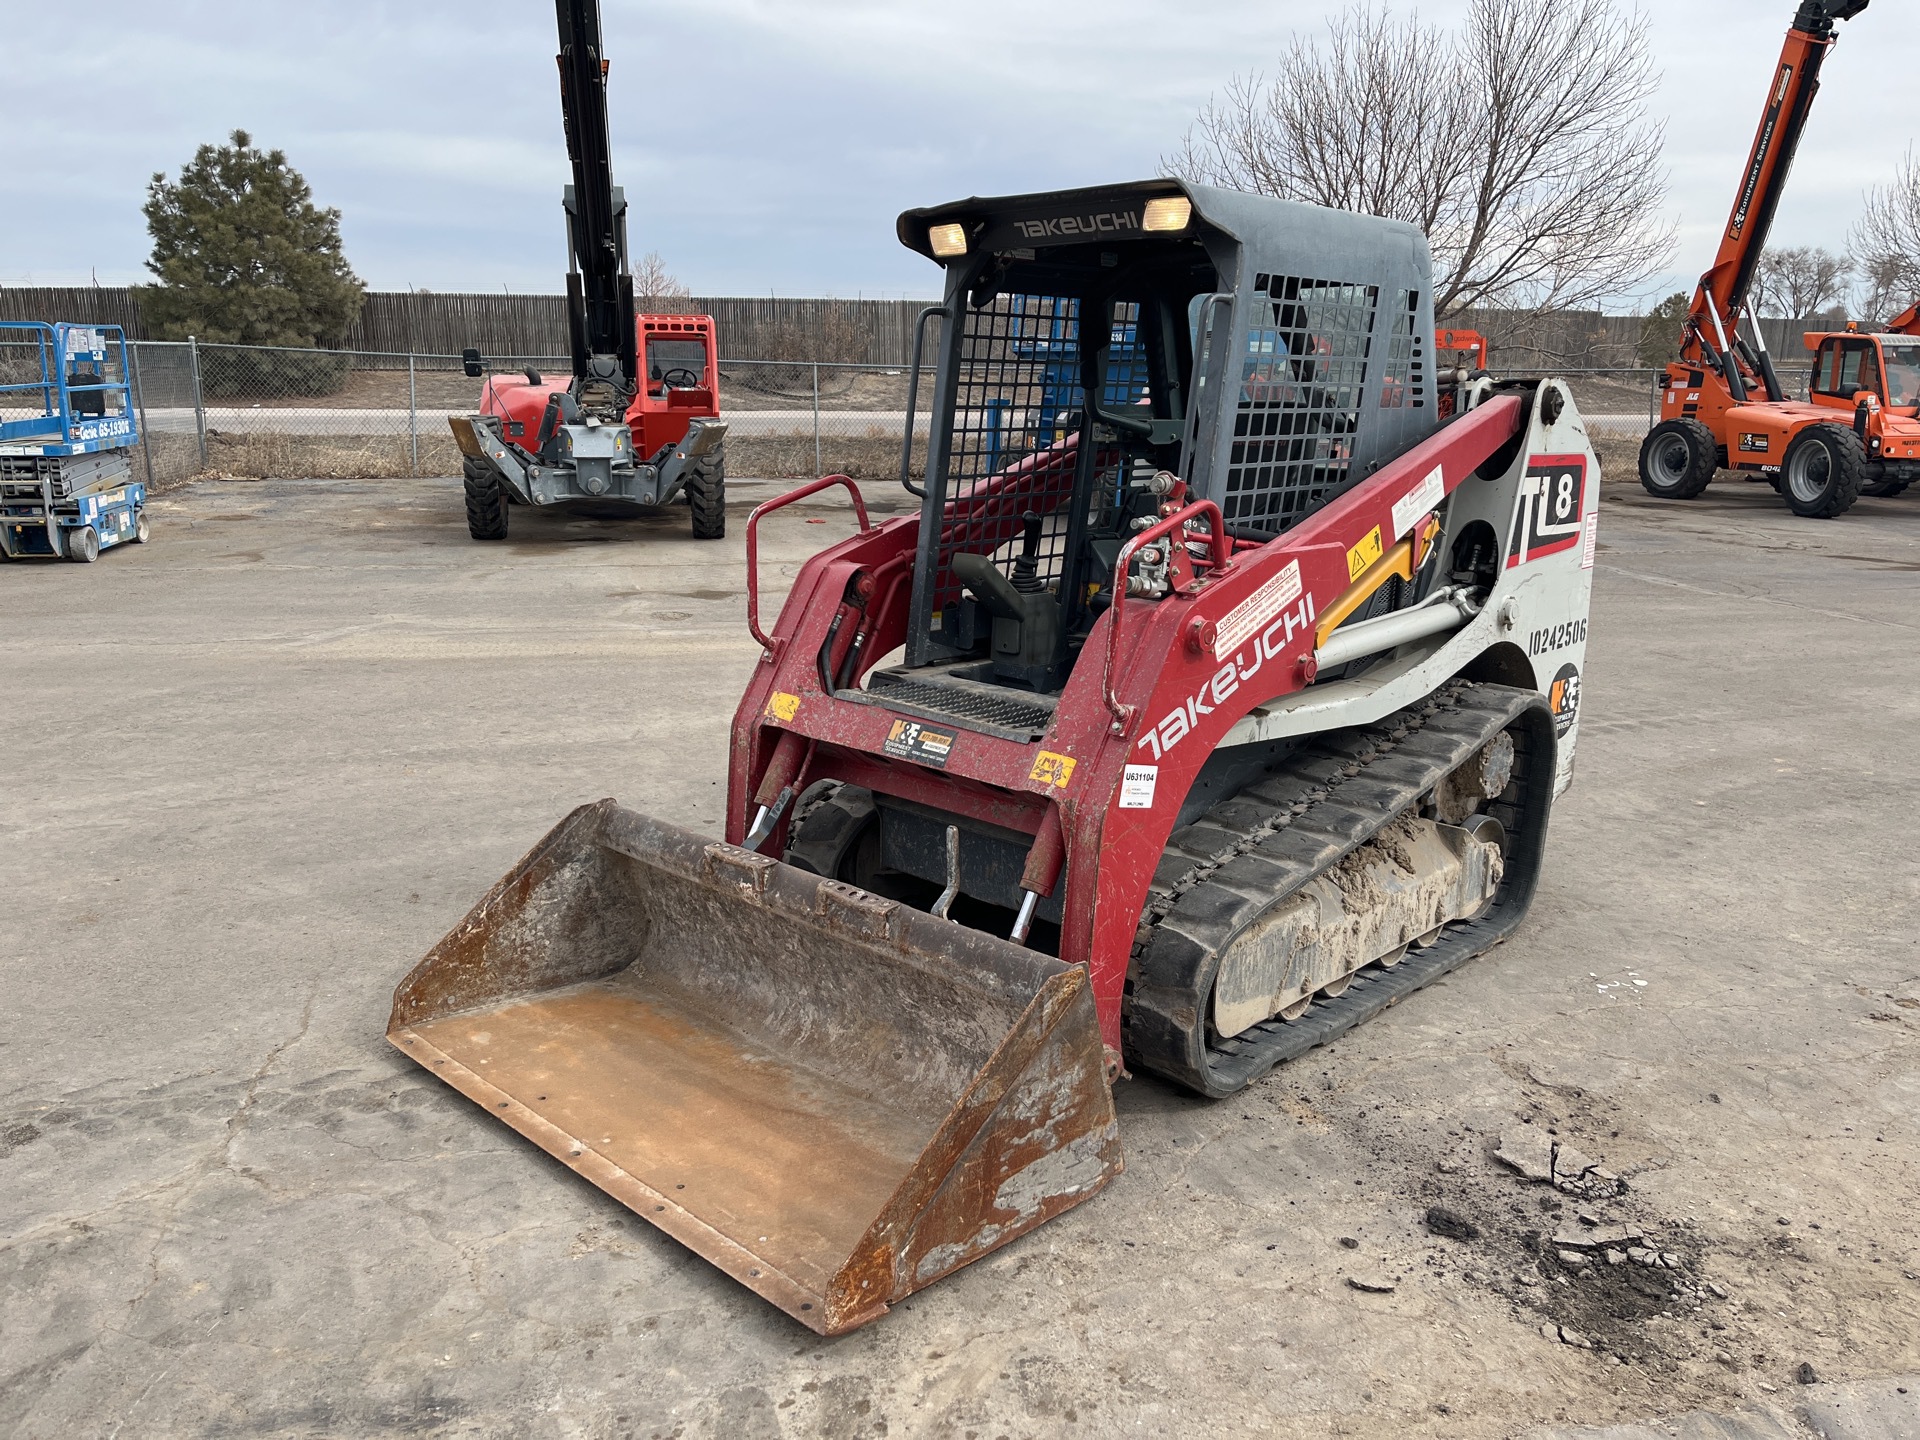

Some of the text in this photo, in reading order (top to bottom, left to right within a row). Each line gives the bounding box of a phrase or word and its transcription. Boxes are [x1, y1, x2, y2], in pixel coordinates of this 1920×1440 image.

[1013, 211, 1139, 238] TAKEUCHI
[1686, 393, 1699, 401] JLG
[1518, 473, 1581, 565] TL8
[1219, 565, 1292, 630] CUSTOMER RESPONSIBILITY
[1528, 618, 1587, 658] 10242506
[1137, 591, 1316, 761] TAKEUCHI
[1551, 675, 1581, 715] H&E
[887, 719, 921, 746] H&E
[1125, 772, 1155, 782] U631104
